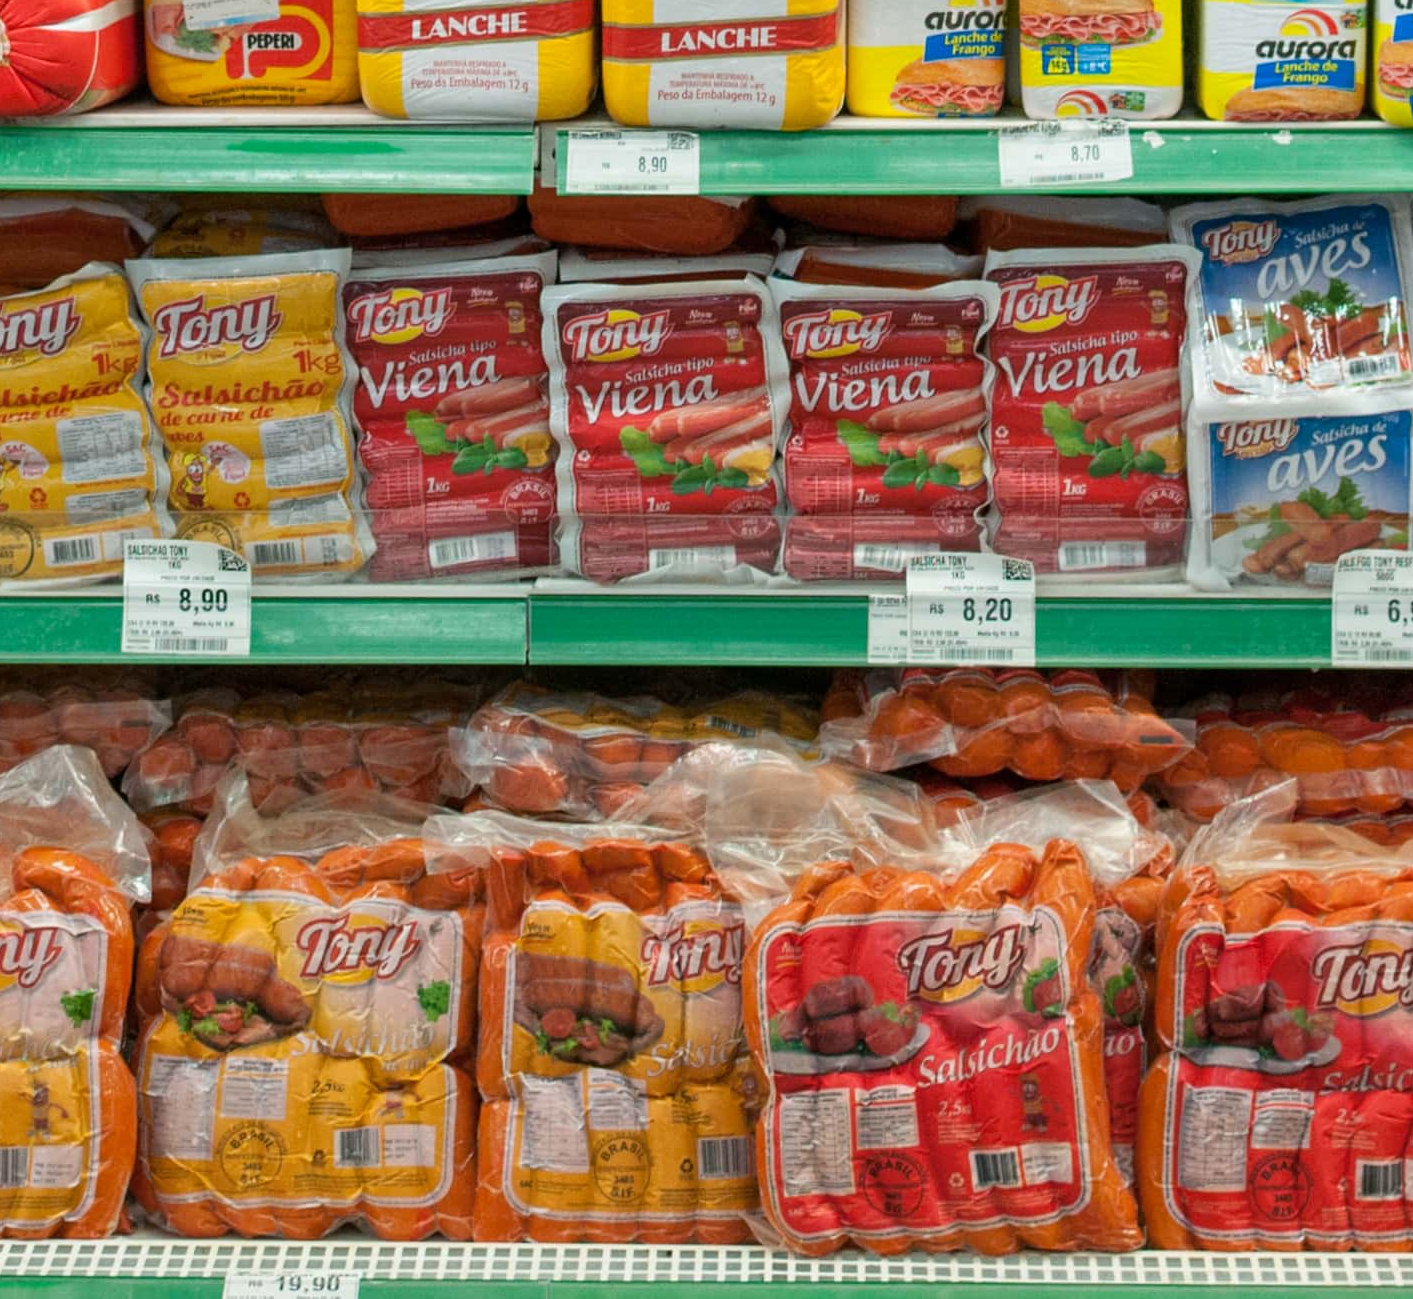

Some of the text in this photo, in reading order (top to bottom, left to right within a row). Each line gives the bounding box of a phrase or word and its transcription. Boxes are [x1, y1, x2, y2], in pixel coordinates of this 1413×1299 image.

[412, 12, 527, 40] LANCHE
[410, 79, 433, 89] Peso
[434, 78, 446, 88] da
[450, 77, 506, 90] Embalagem
[509, 80, 520, 89] 12
[658, 90, 679, 100] Peso
[682, 90, 693, 100] da
[696, 89, 752, 102] Embalagem
[756, 92, 767, 103] 12
[638, 155, 667, 174] 8,90
[1070, 143, 1099, 162] 8,70
[156, 295, 282, 358] Tony
[408, 338, 498, 365] Salsicha tipo
[1049, 329, 1138, 358] Salsicha tipo
[359, 352, 502, 408] Viena
[795, 366, 935, 412] Viena
[1267, 432, 1389, 494] aves
[128, 545, 188, 557] SALSICHAO TONY
[948, 556, 967, 566] TONY
[146, 588, 228, 616] R$ 8,90
[930, 598, 1012, 625] R$ 8,20
[297, 913, 420, 978] Tony
[644, 924, 746, 985] Tony
[901, 925, 1024, 1000] Tony
[914, 1028, 1061, 1090] Salsichão
[227, 1134, 275, 1158] BRASIL
[275, 1274, 342, 1293] 19,90
